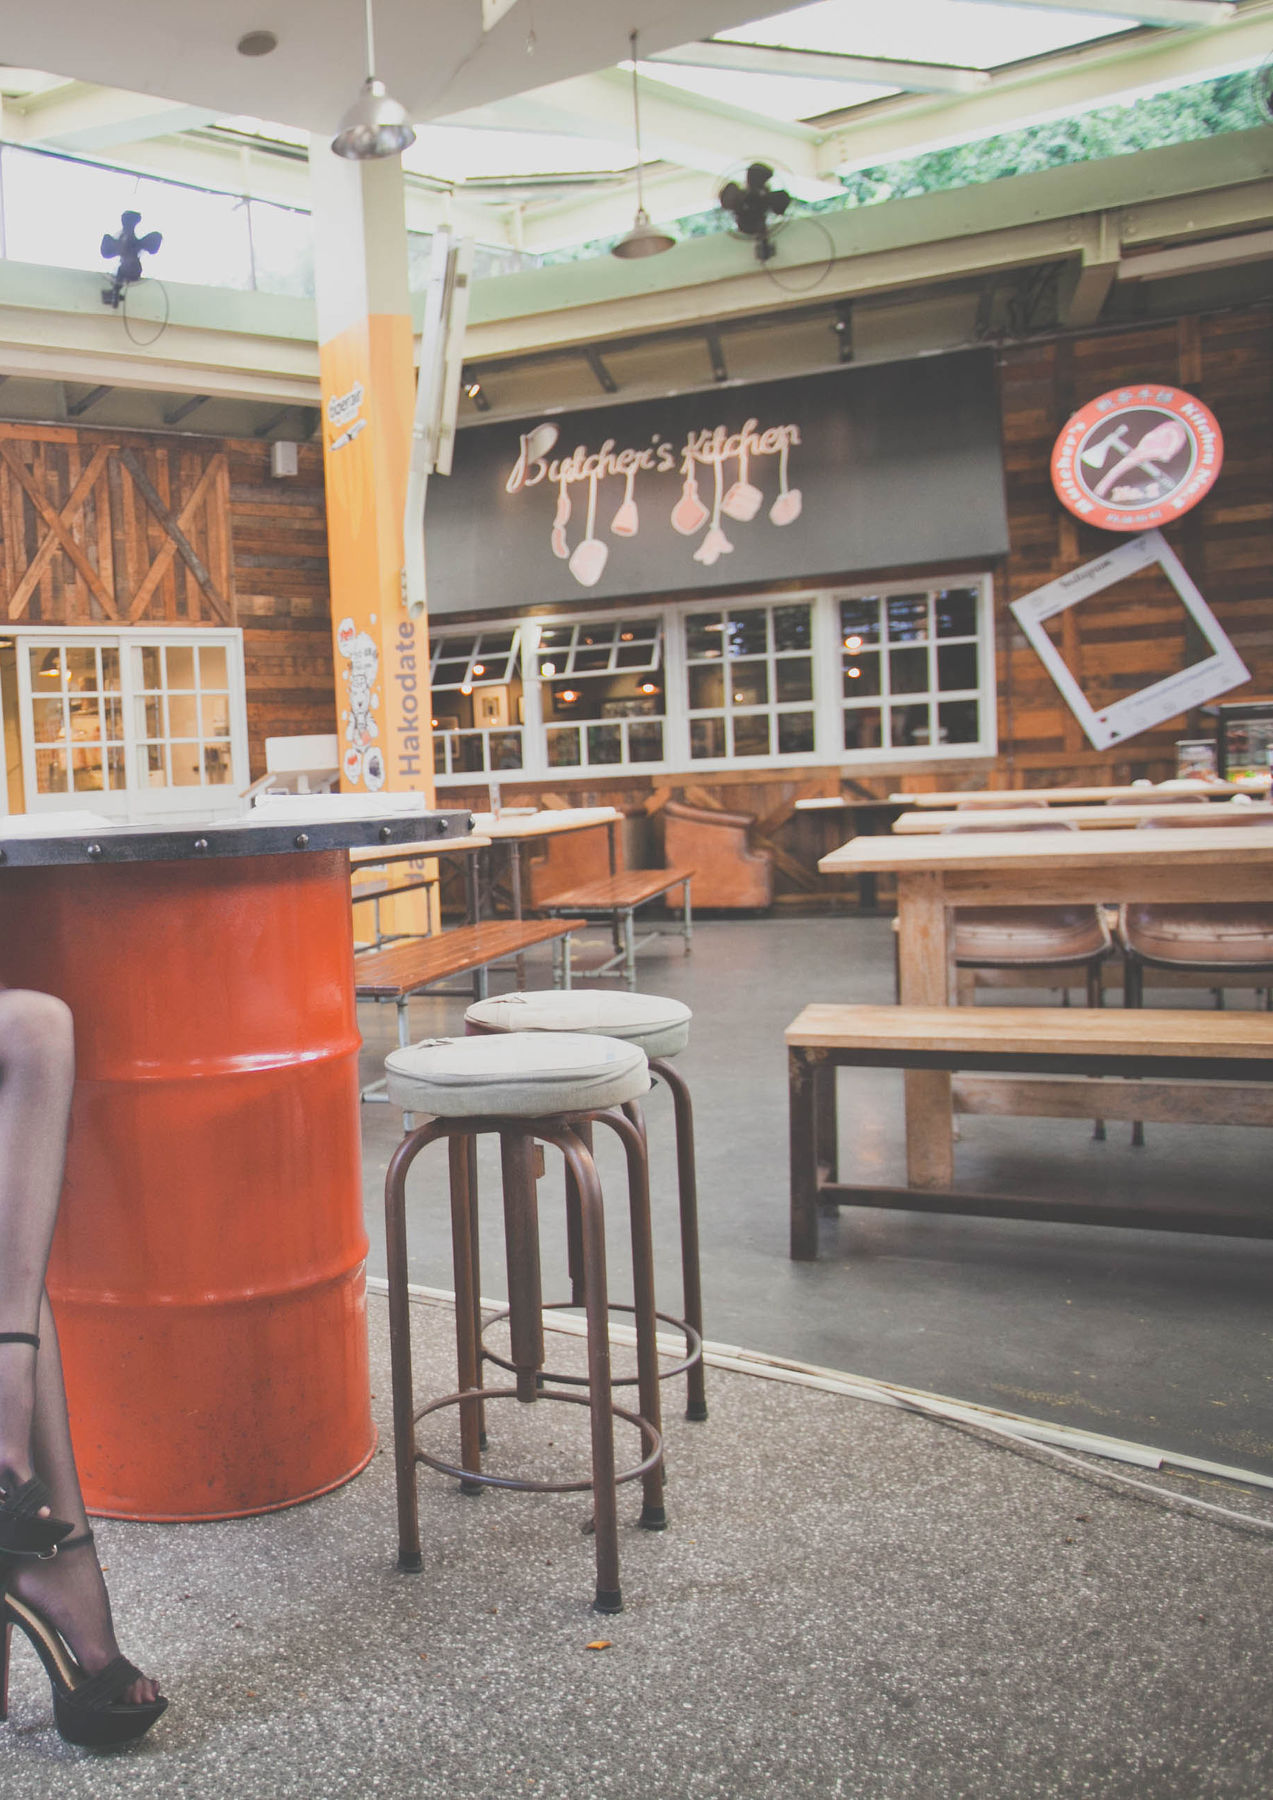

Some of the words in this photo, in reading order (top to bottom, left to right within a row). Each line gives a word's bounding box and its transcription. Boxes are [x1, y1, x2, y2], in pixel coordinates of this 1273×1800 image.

[505, 422, 676, 494] Butcher's
[679, 417, 802, 475] Kitchen
[1180, 402, 1217, 465] Kitchen
[395, 621, 422, 776] Hakodate
